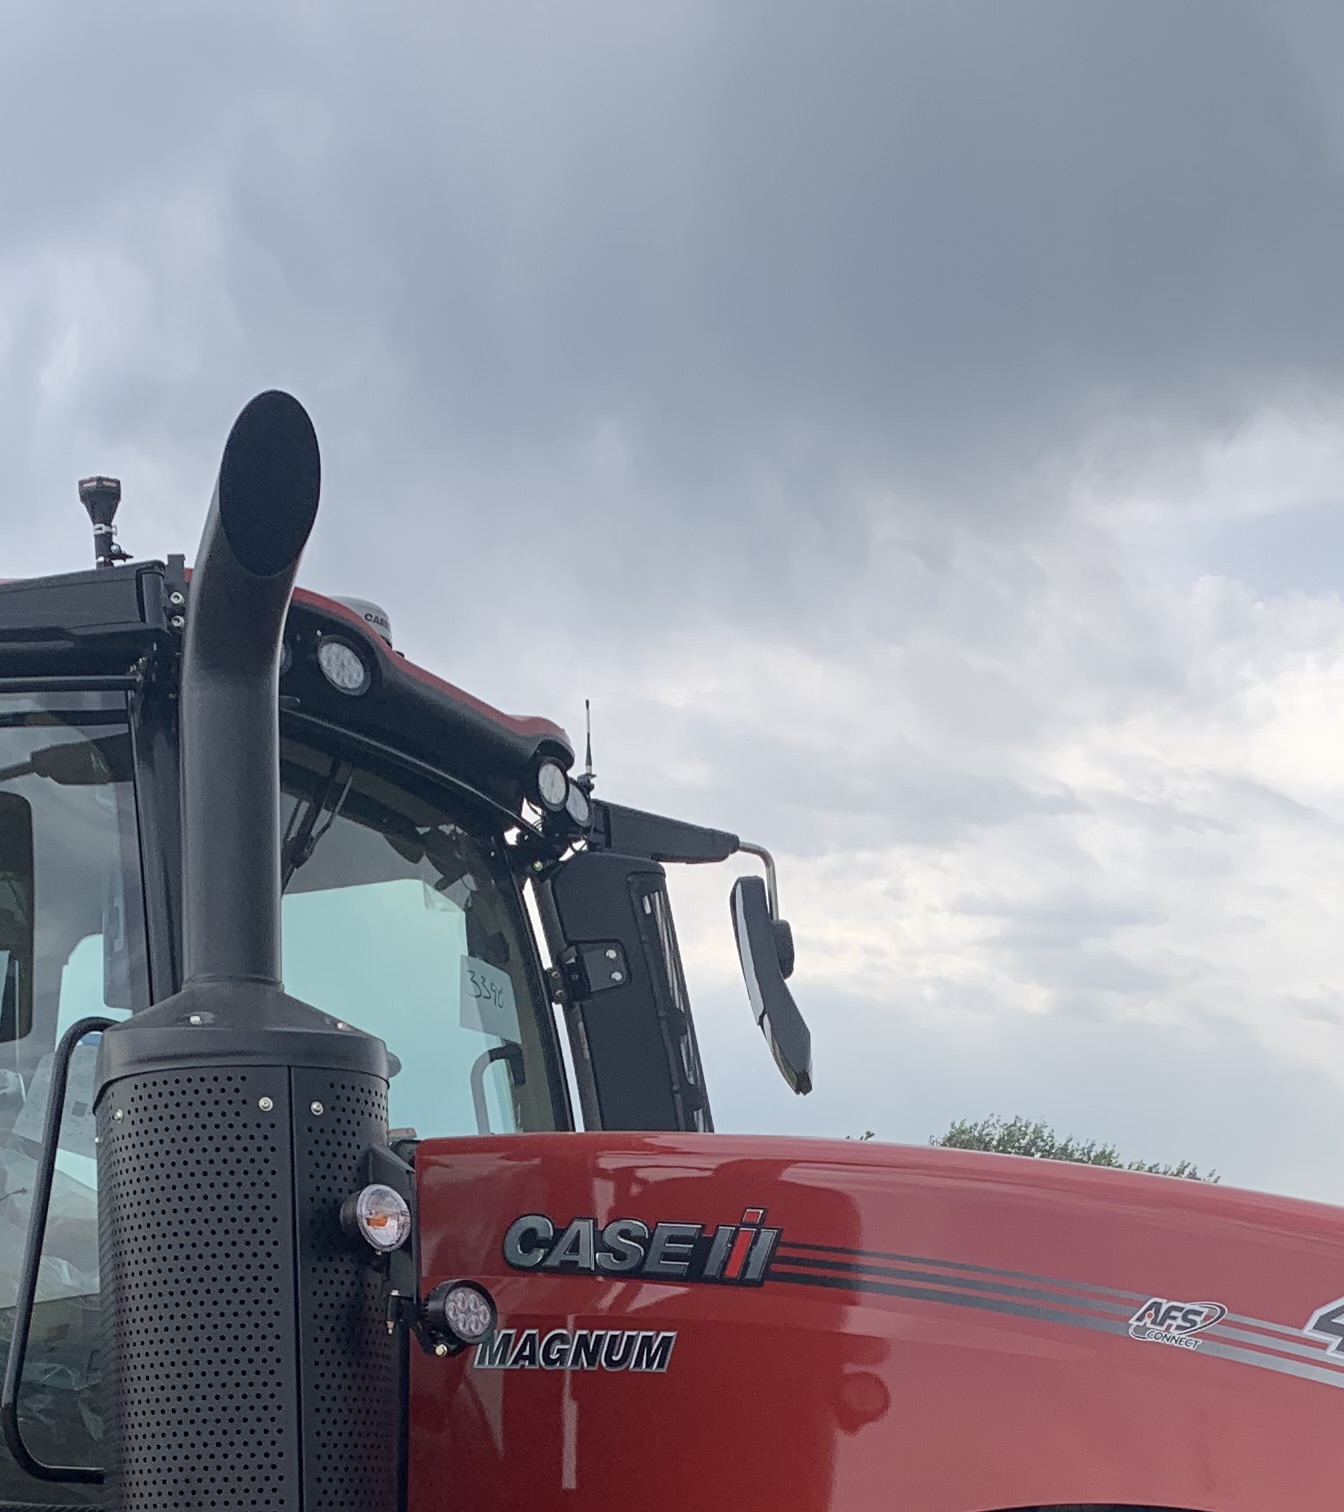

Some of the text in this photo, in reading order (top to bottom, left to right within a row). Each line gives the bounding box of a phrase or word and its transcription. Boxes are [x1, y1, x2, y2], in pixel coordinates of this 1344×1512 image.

[503, 1214, 704, 1277] CASE
[1130, 1298, 1206, 1332] AFS
[474, 1329, 677, 1373] MAGNUM
[1146, 1330, 1201, 1349] CONNECT
